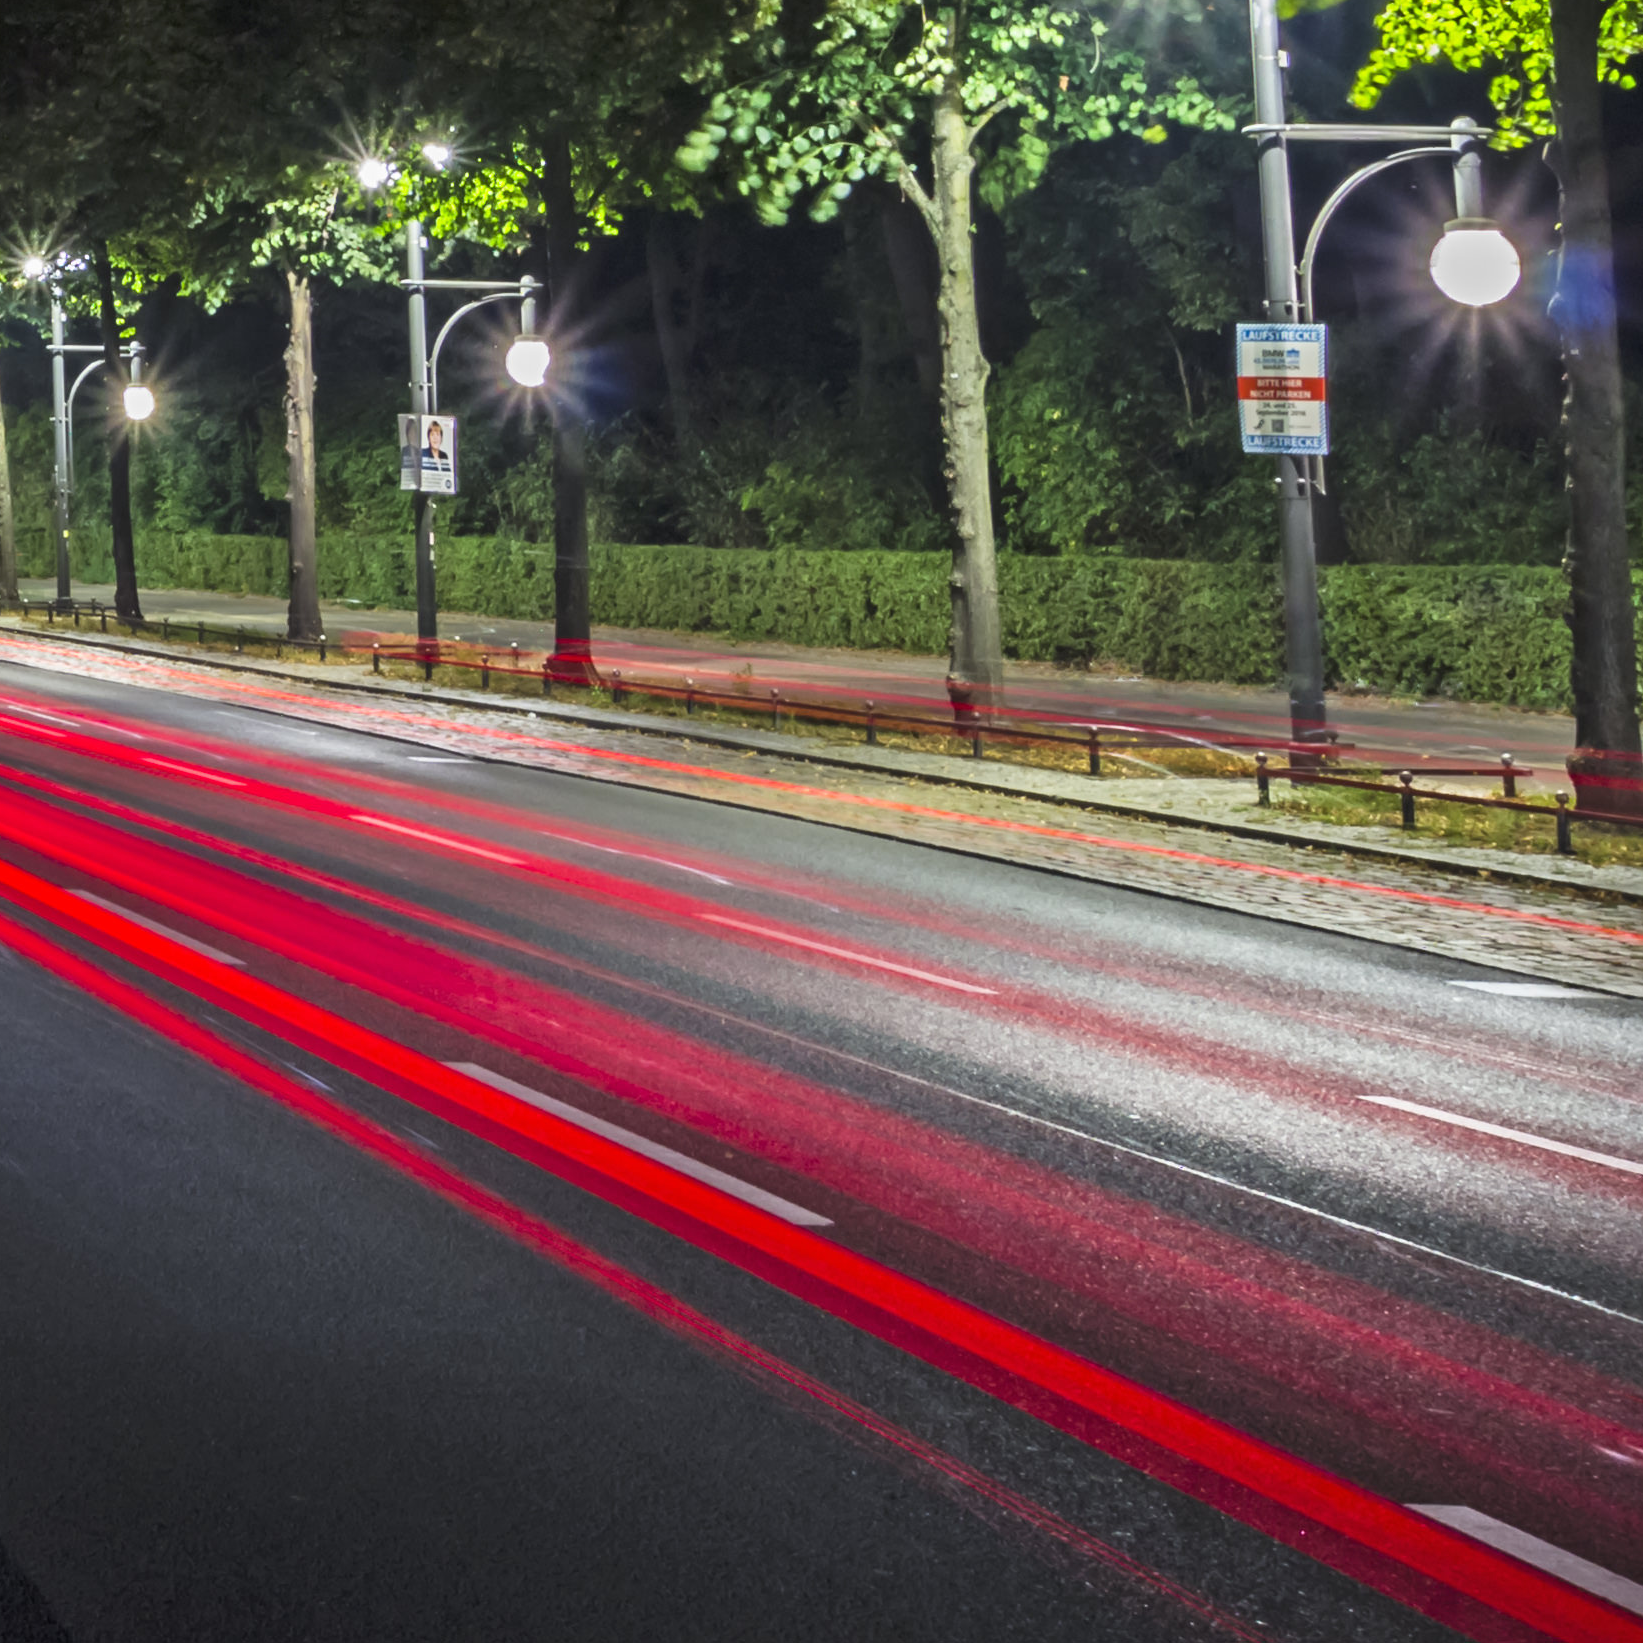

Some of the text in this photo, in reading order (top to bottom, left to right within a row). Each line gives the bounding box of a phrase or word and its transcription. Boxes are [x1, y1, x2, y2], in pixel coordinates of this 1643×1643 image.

[1242, 331, 1318, 341] LAUFSTRECKE
[1262, 349, 1285, 357] BMW
[1257, 379, 1302, 388] BITTE HIER
[1249, 390, 1311, 399] NICHT PARKEN
[1248, 437, 1319, 447] LAUFSTRECKE
